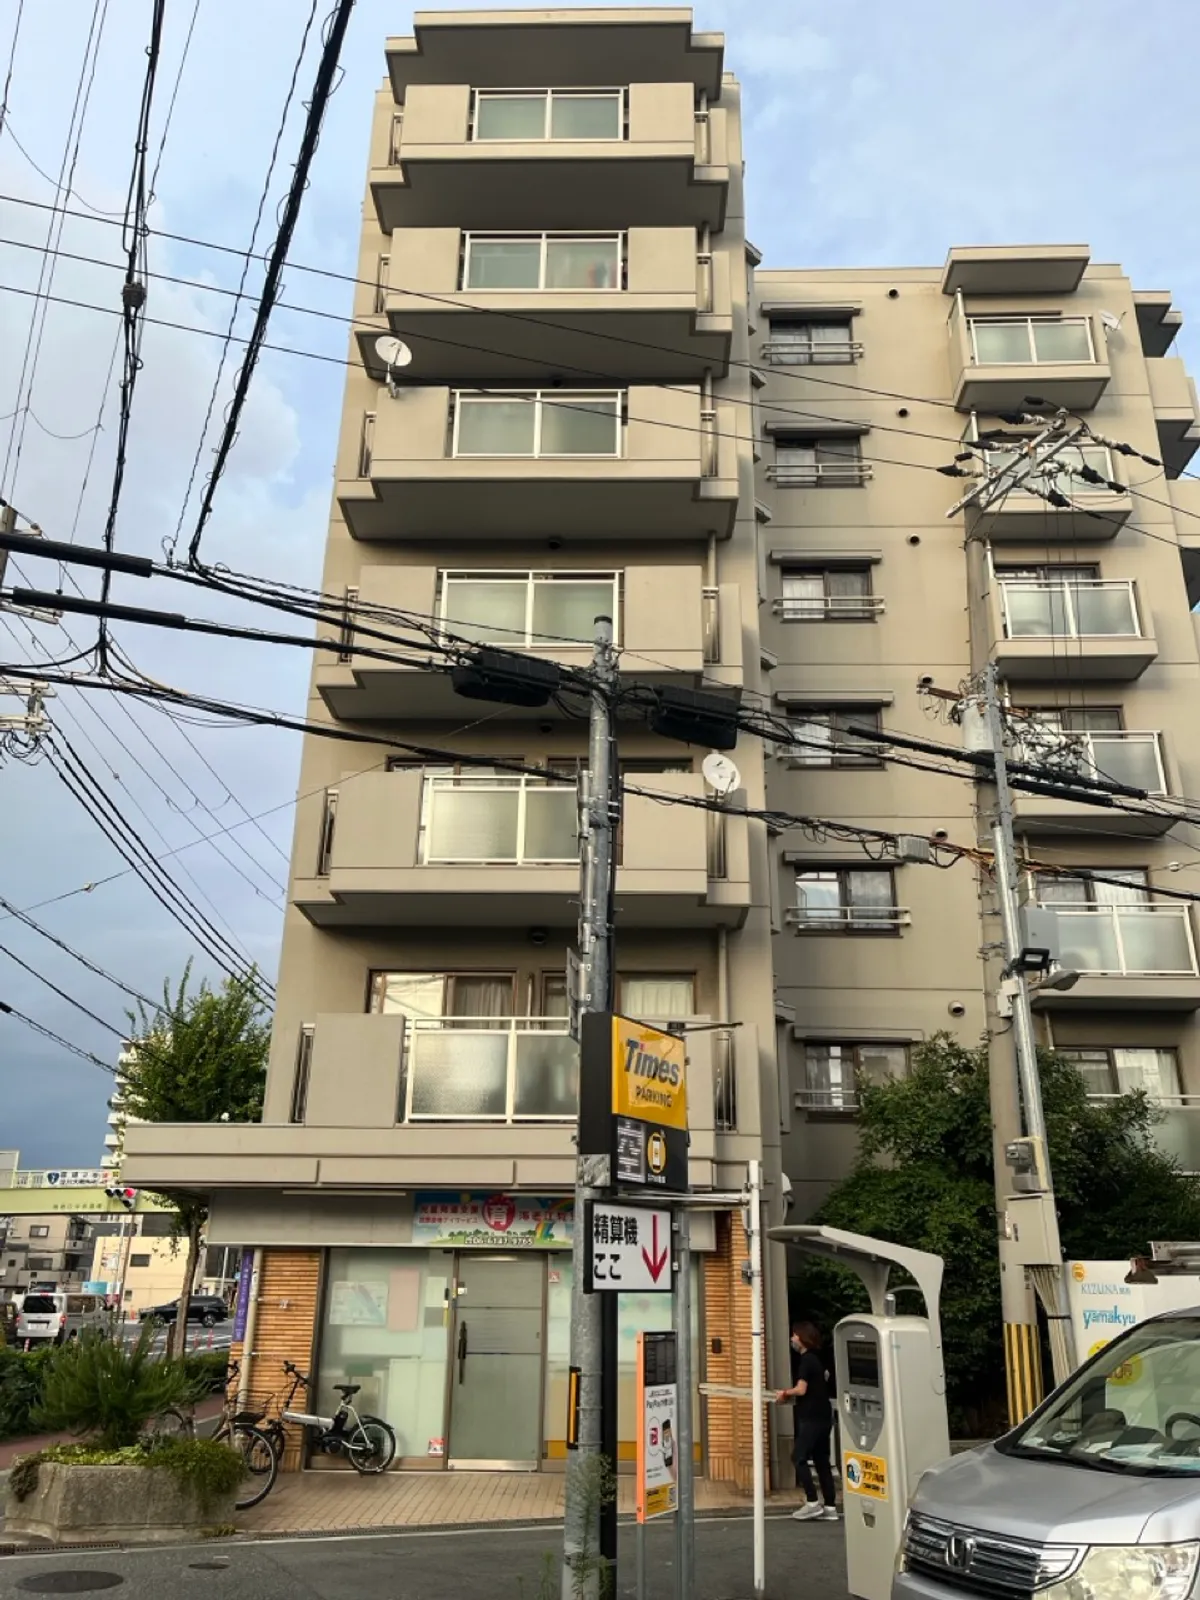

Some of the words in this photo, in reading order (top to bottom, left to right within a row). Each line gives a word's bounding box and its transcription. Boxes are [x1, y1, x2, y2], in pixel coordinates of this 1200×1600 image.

[623, 1038, 681, 1088] Times
[635, 1085, 673, 1108] PARKING
[593, 1213, 638, 1246] 精算機
[594, 1253, 622, 1281] ここ
[1083, 1305, 1137, 1329] yamakyu
